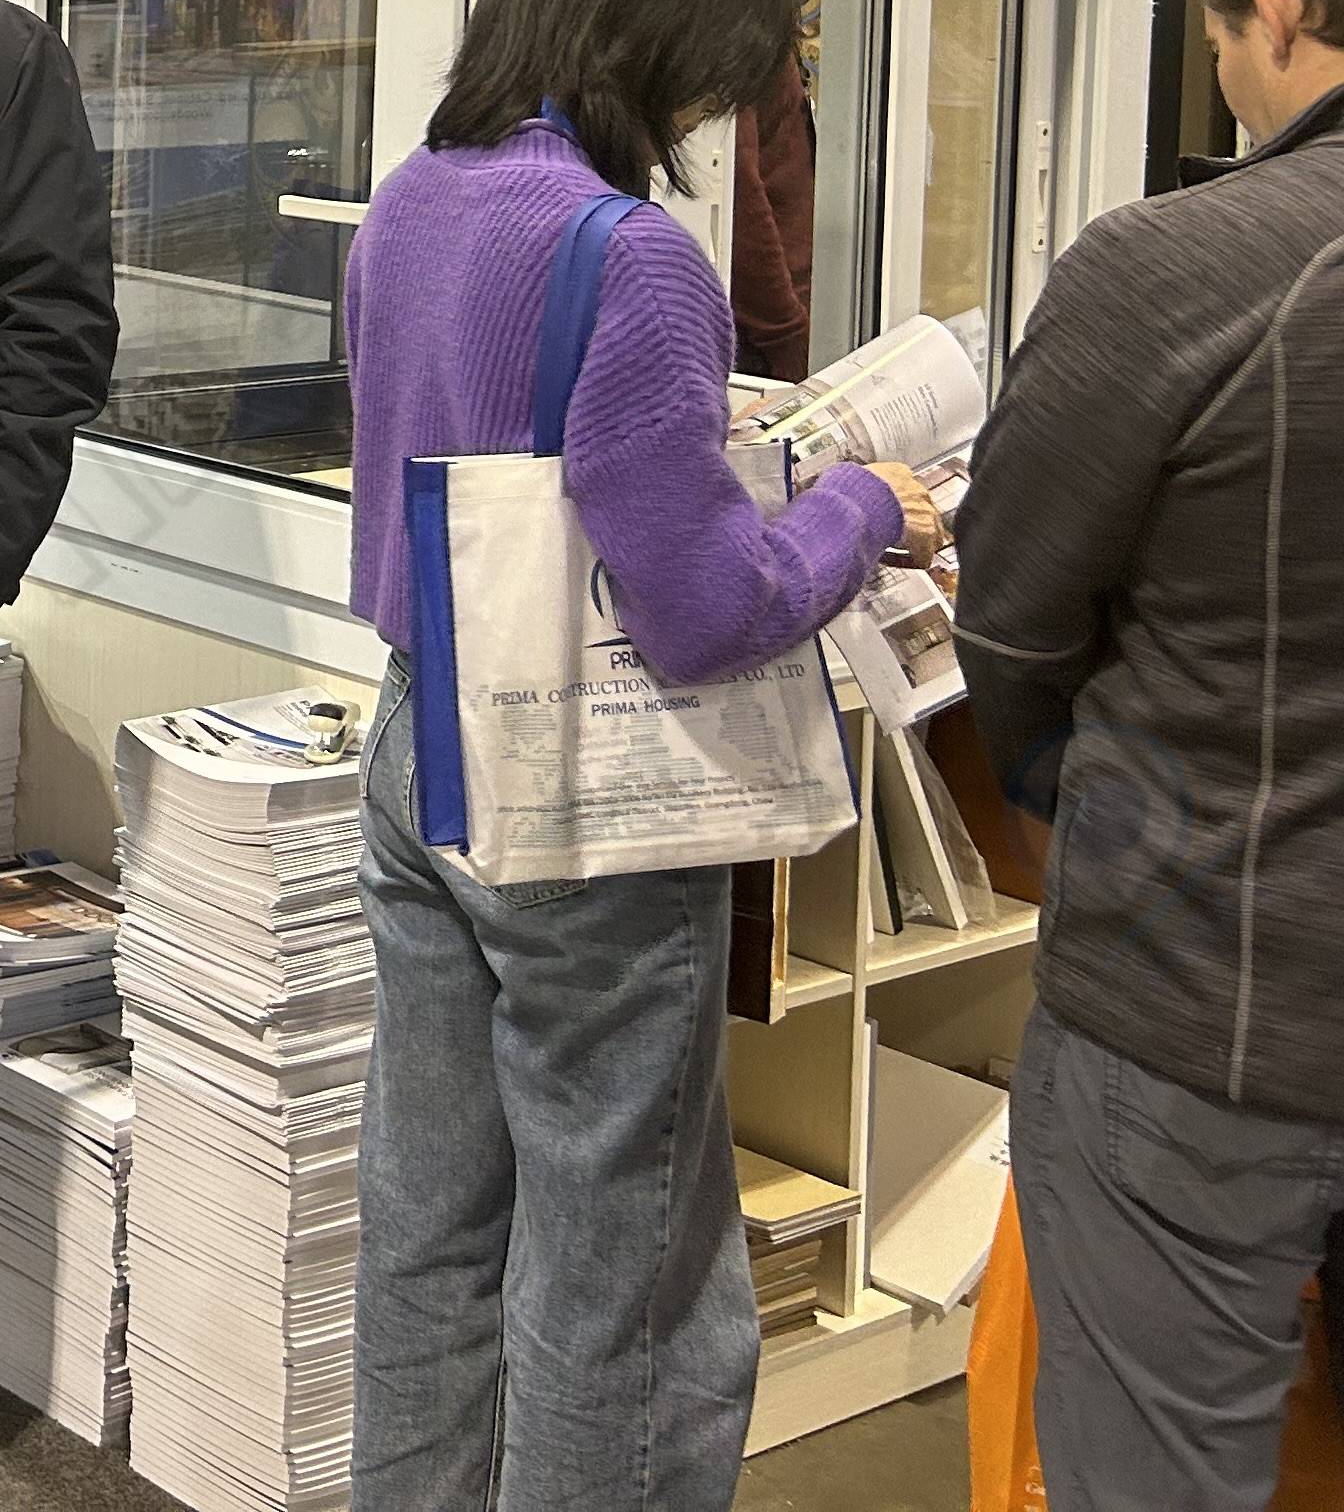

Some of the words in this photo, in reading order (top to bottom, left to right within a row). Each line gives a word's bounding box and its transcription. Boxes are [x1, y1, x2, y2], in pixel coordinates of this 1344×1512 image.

[491, 689, 540, 707] PRIMA
[778, 663, 805, 679] LTD
[591, 701, 638, 717] PRIMA
[644, 695, 701, 711] HOUSING
